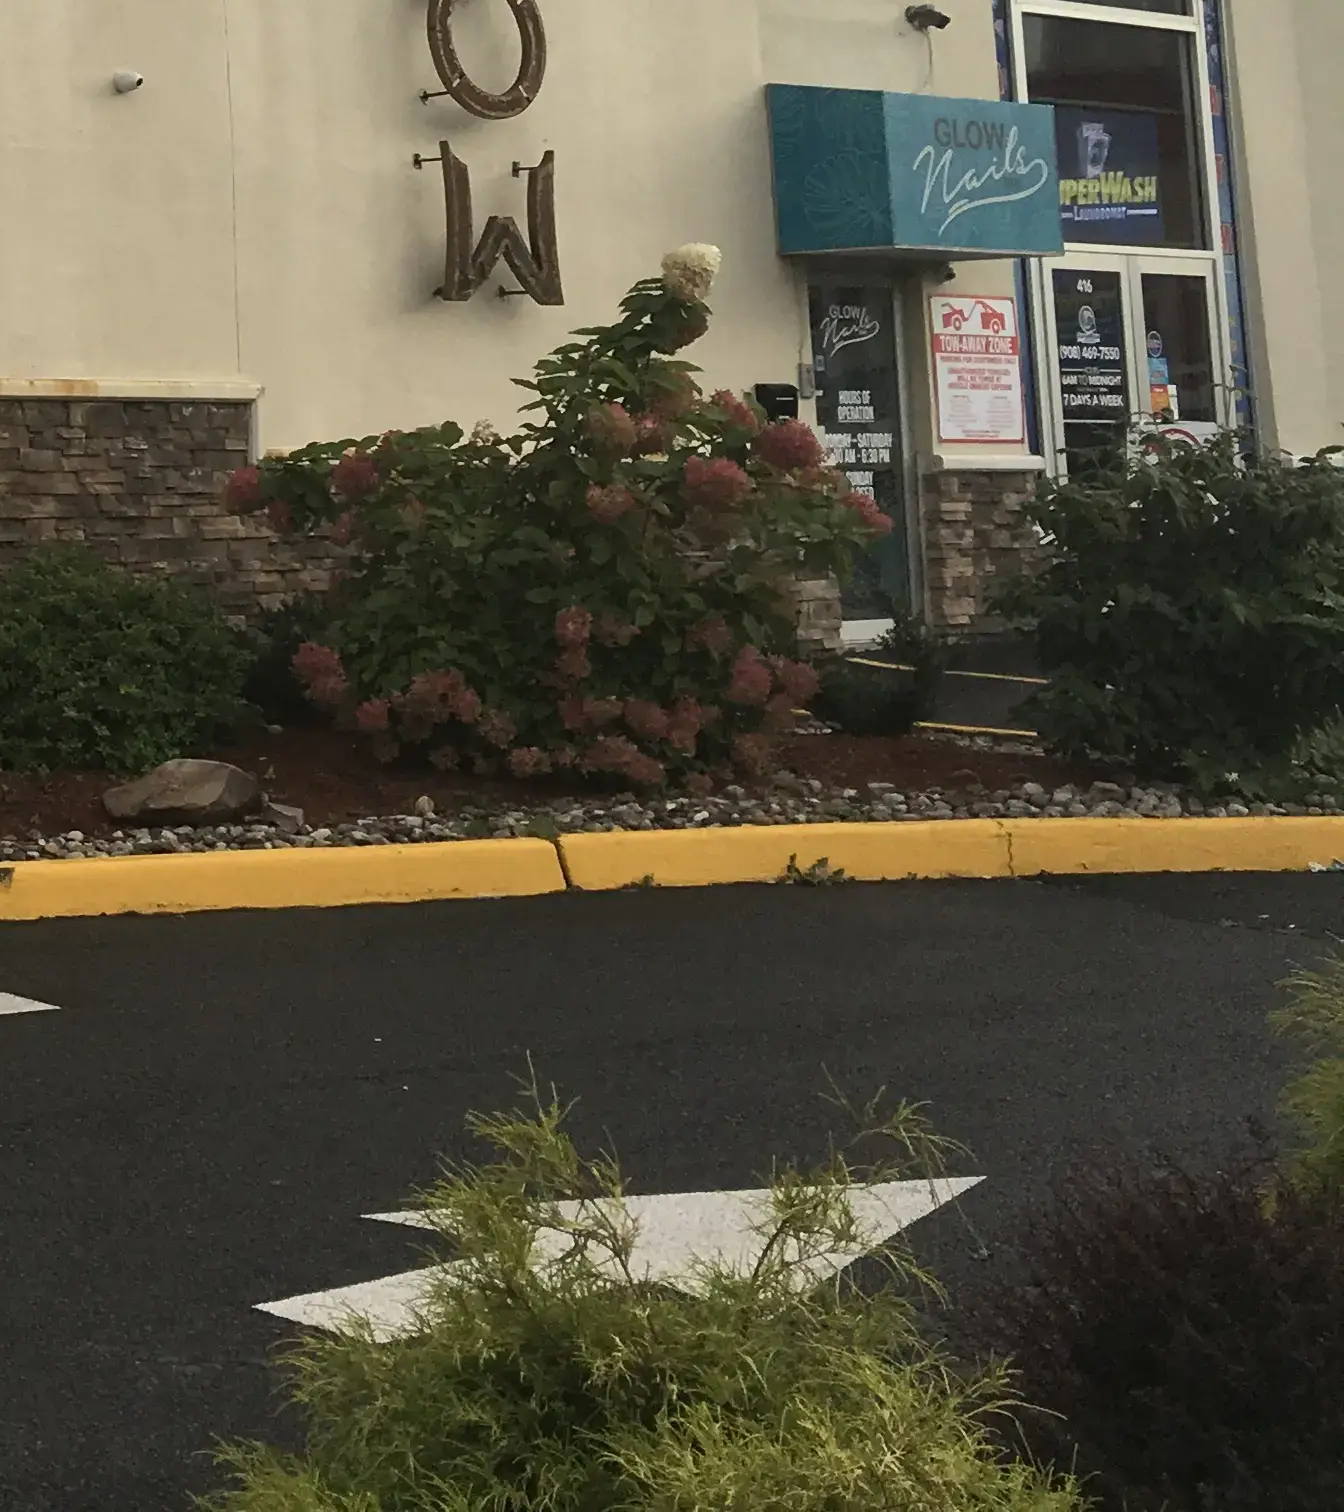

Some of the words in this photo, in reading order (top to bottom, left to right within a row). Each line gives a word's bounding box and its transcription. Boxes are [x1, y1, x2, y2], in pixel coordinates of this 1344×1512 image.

[933, 117, 1004, 150] GLOW
[912, 125, 1048, 236] Nails
[1059, 171, 1158, 206] PERWASH
[940, 335, 987, 353] TOW-AWAY
[988, 336, 1013, 354] ZONE
[1070, 394, 1091, 406] DAYS
[1092, 394, 1099, 406] A
[1100, 394, 1124, 407] WEEK
